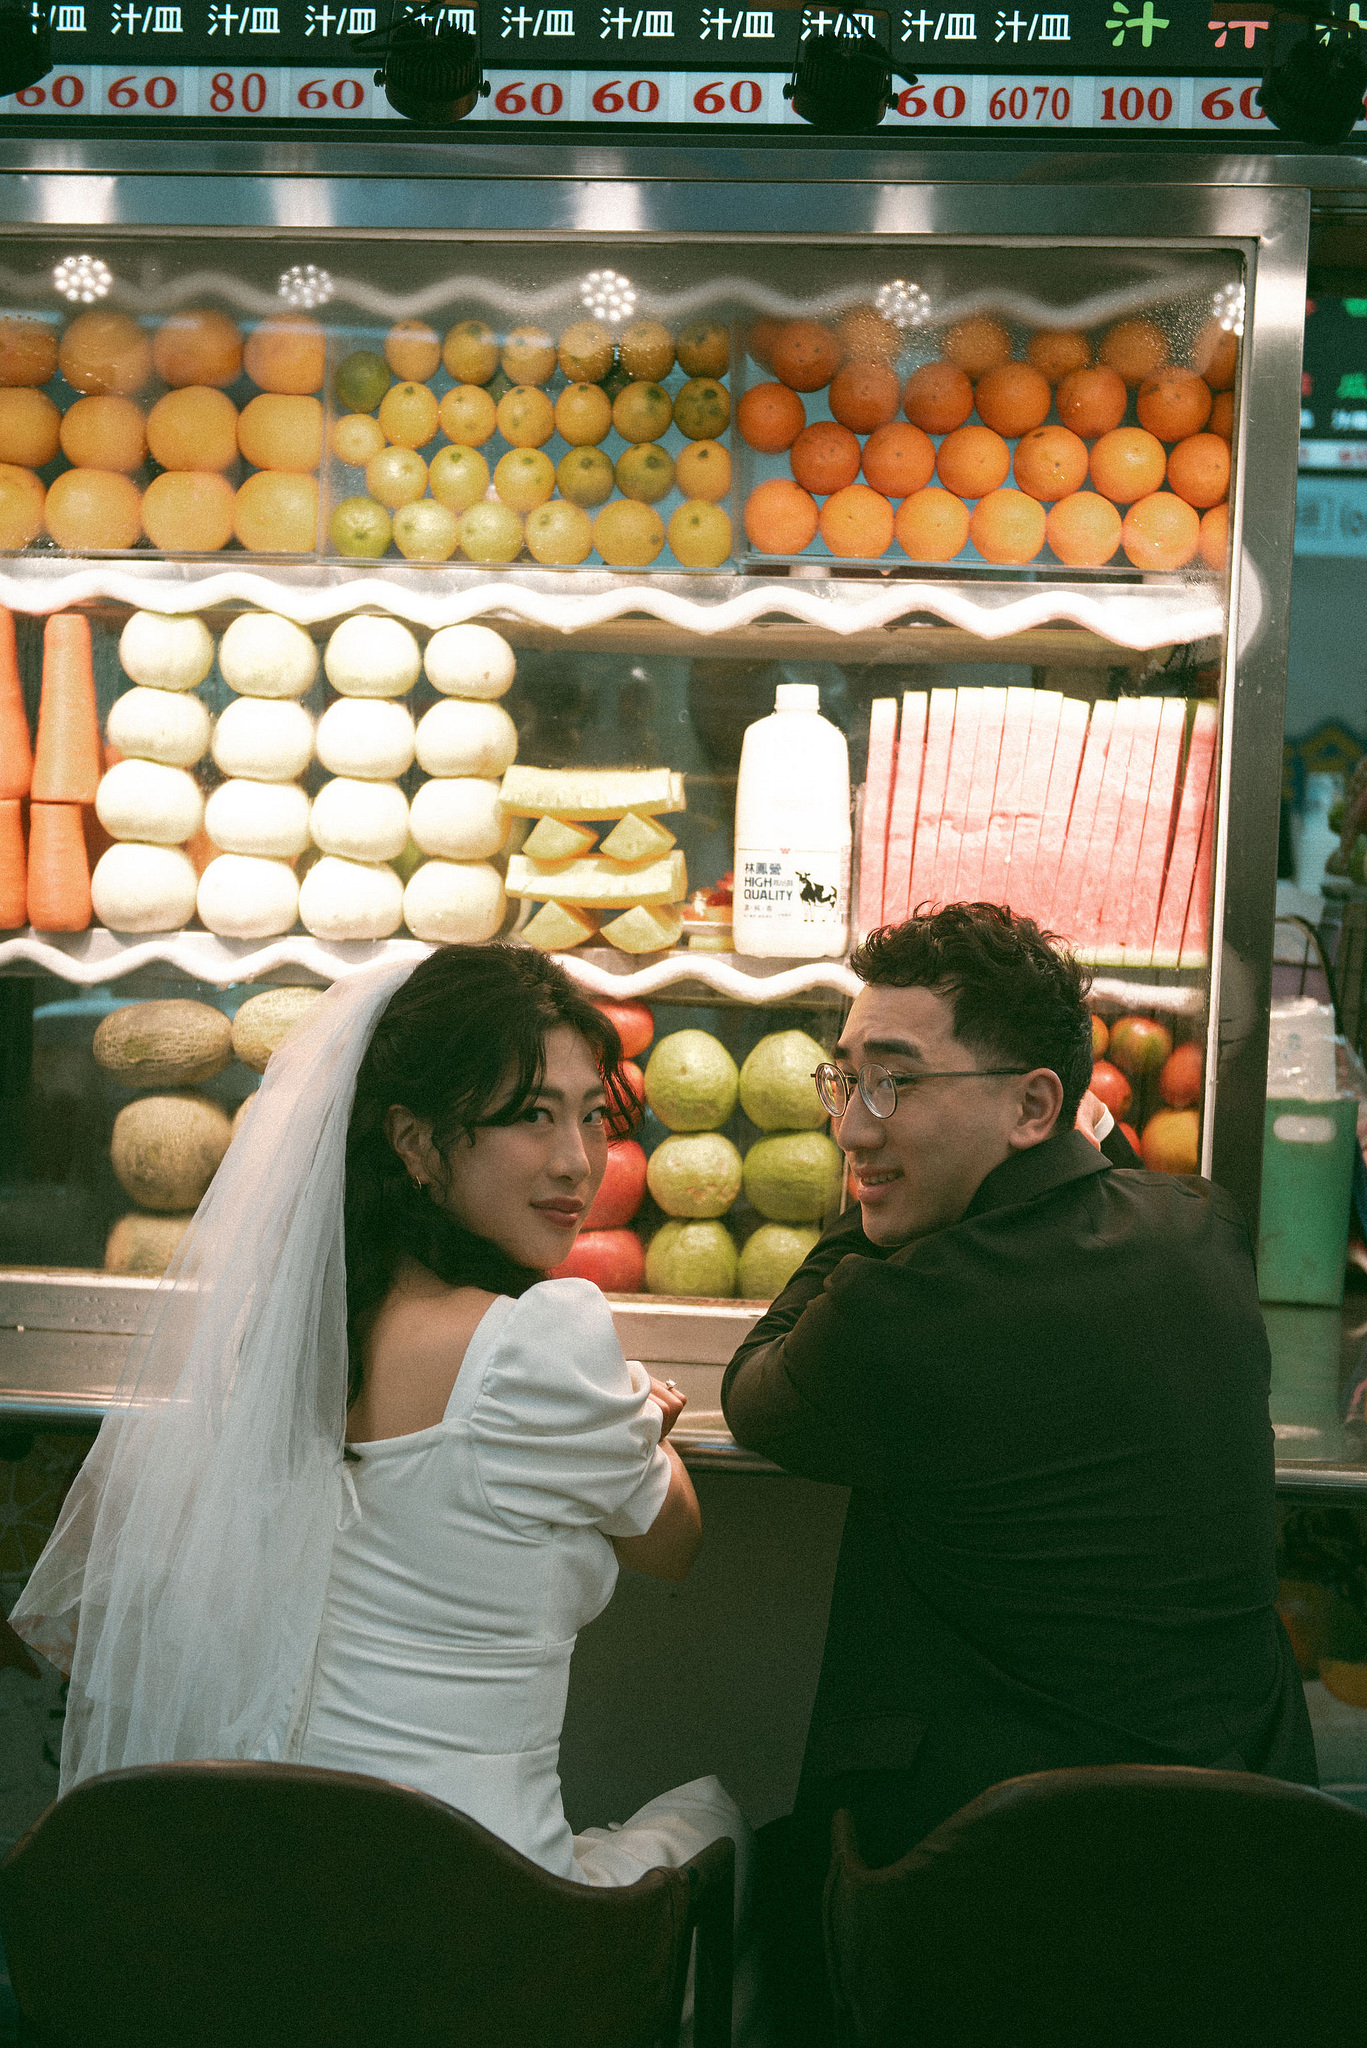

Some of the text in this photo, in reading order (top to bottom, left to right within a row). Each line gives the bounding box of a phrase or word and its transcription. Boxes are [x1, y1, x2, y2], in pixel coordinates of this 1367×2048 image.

[110, 3, 184, 36] 汁/皿
[207, 3, 281, 37] 汁/皿
[304, 5, 377, 38] 汁/皿
[501, 6, 576, 39] 汁/皿
[599, 7, 675, 40] 汁/皿
[699, 7, 775, 41] 汁/皿
[900, 9, 977, 43] 汁/皿
[994, 10, 1071, 44] 汁/皿
[1105, 1, 1170, 47] 汁
[107, 75, 177, 109] 60
[210, 72, 266, 113] 80
[297, 78, 364, 109] 60
[494, 81, 563, 116] 60
[592, 79, 660, 113] 60
[693, 80, 763, 115] 60
[896, 84, 967, 119] 60
[1100, 86, 1172, 121] 100
[744, 877, 772, 887] HIGH
[744, 889, 793, 901] QUALITY
